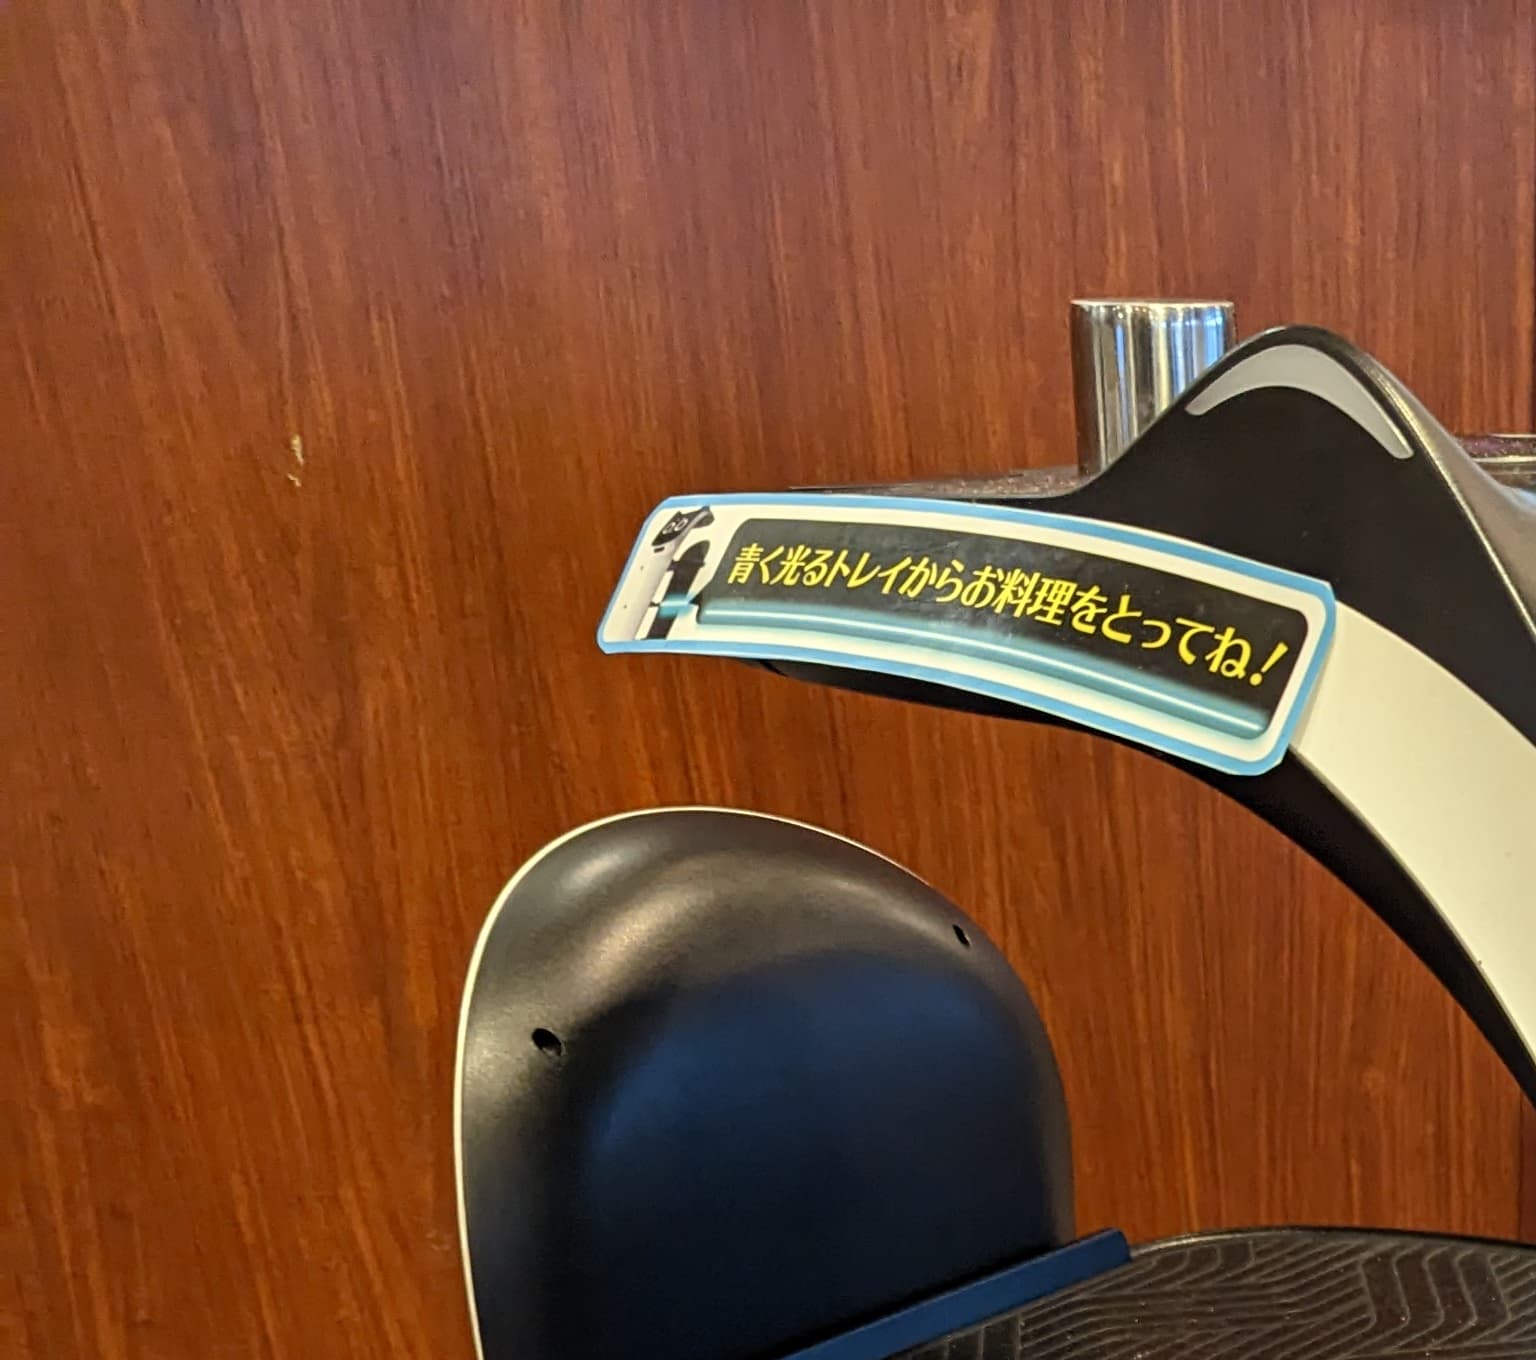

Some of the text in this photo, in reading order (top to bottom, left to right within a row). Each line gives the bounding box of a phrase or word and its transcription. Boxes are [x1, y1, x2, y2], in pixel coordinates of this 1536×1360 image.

[727, 543, 1288, 686] 青く光るトレイからお料理をとってね！
